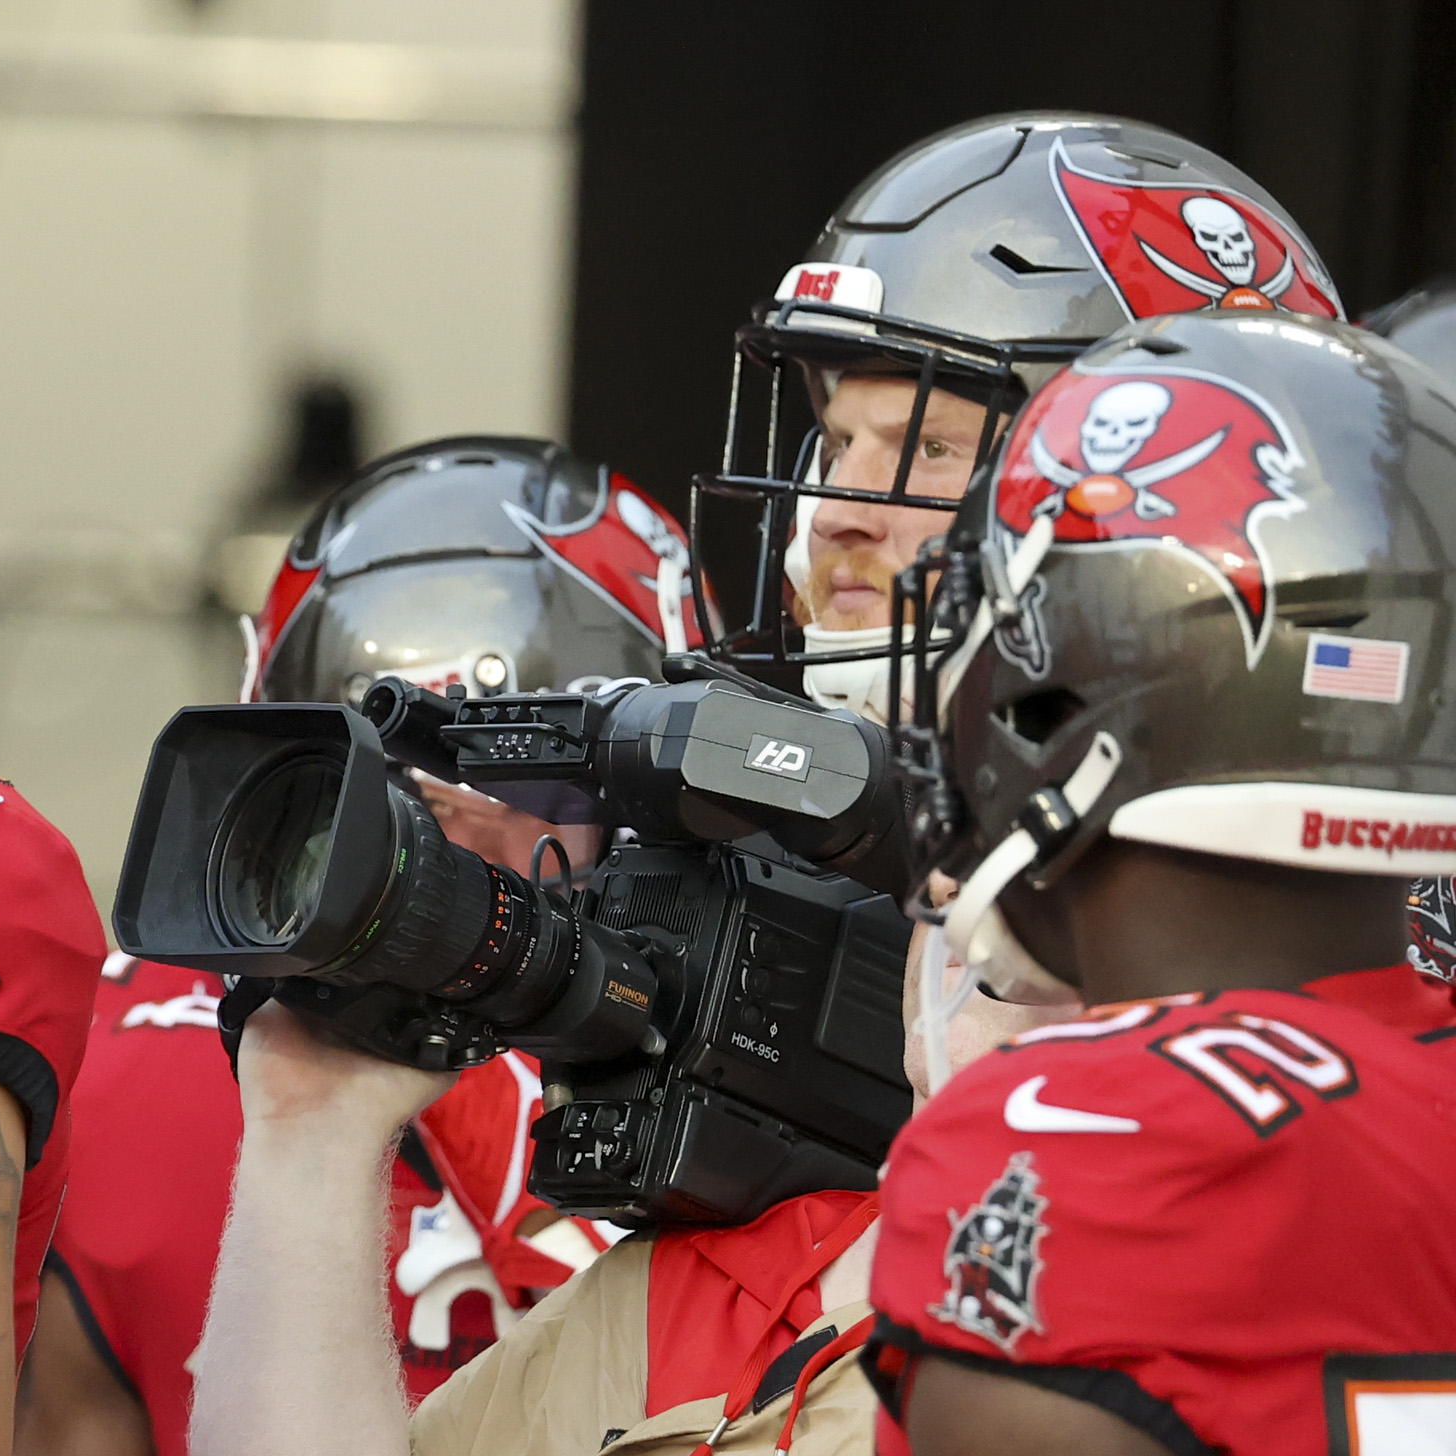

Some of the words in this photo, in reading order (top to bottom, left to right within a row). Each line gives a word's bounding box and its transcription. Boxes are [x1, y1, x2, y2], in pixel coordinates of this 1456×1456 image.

[754, 740, 806, 772] HD
[607, 979, 650, 1005] FUJINON
[731, 1031, 780, 1063] HDK-95C
